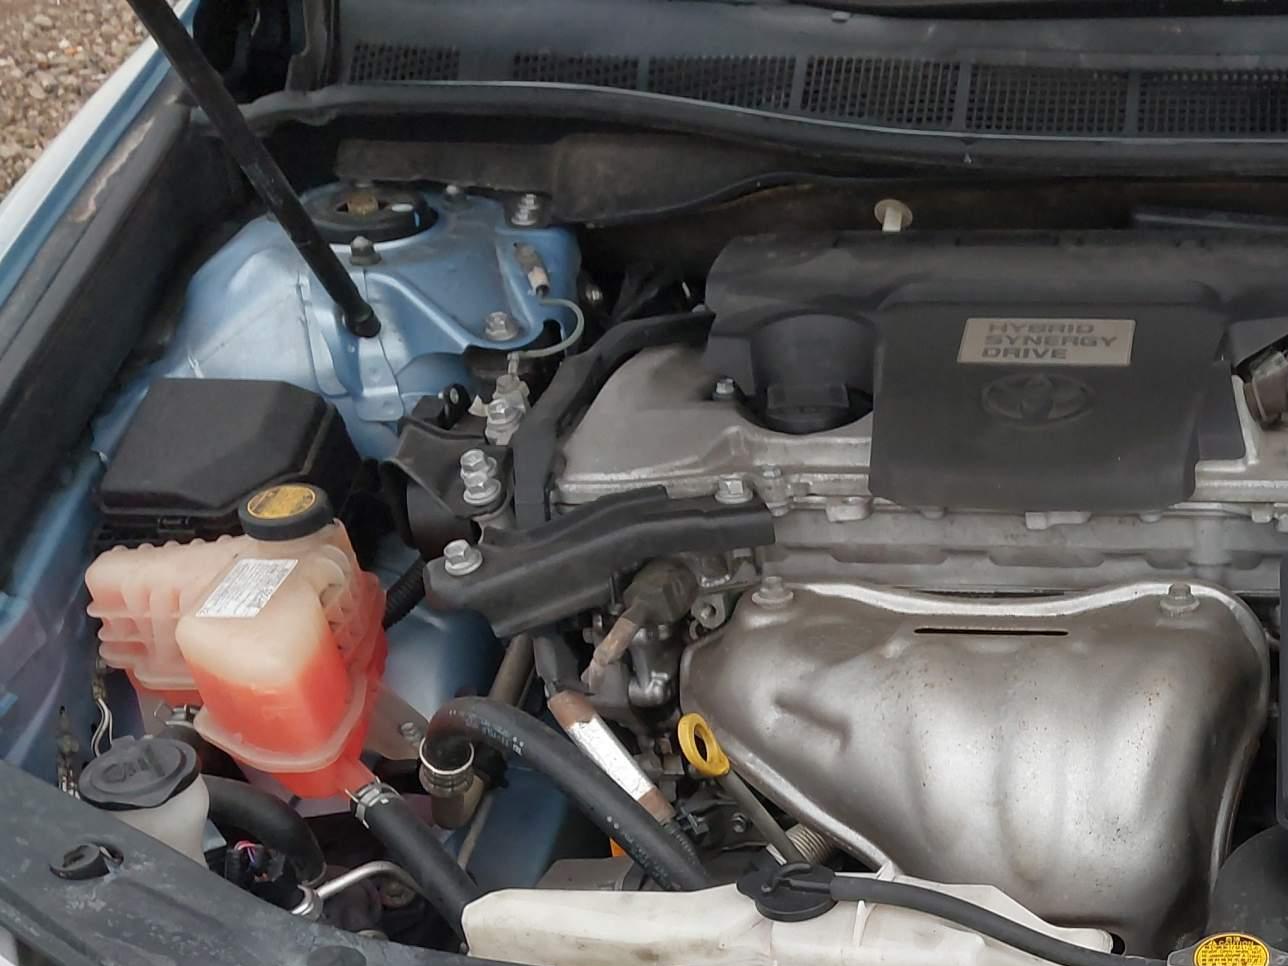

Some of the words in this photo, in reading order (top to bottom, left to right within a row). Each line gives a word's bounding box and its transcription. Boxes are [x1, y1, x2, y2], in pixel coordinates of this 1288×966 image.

[988, 323, 1095, 334] HYBRID
[985, 335, 1118, 347] SYNERGY
[981, 347, 1068, 360] DRIVE
